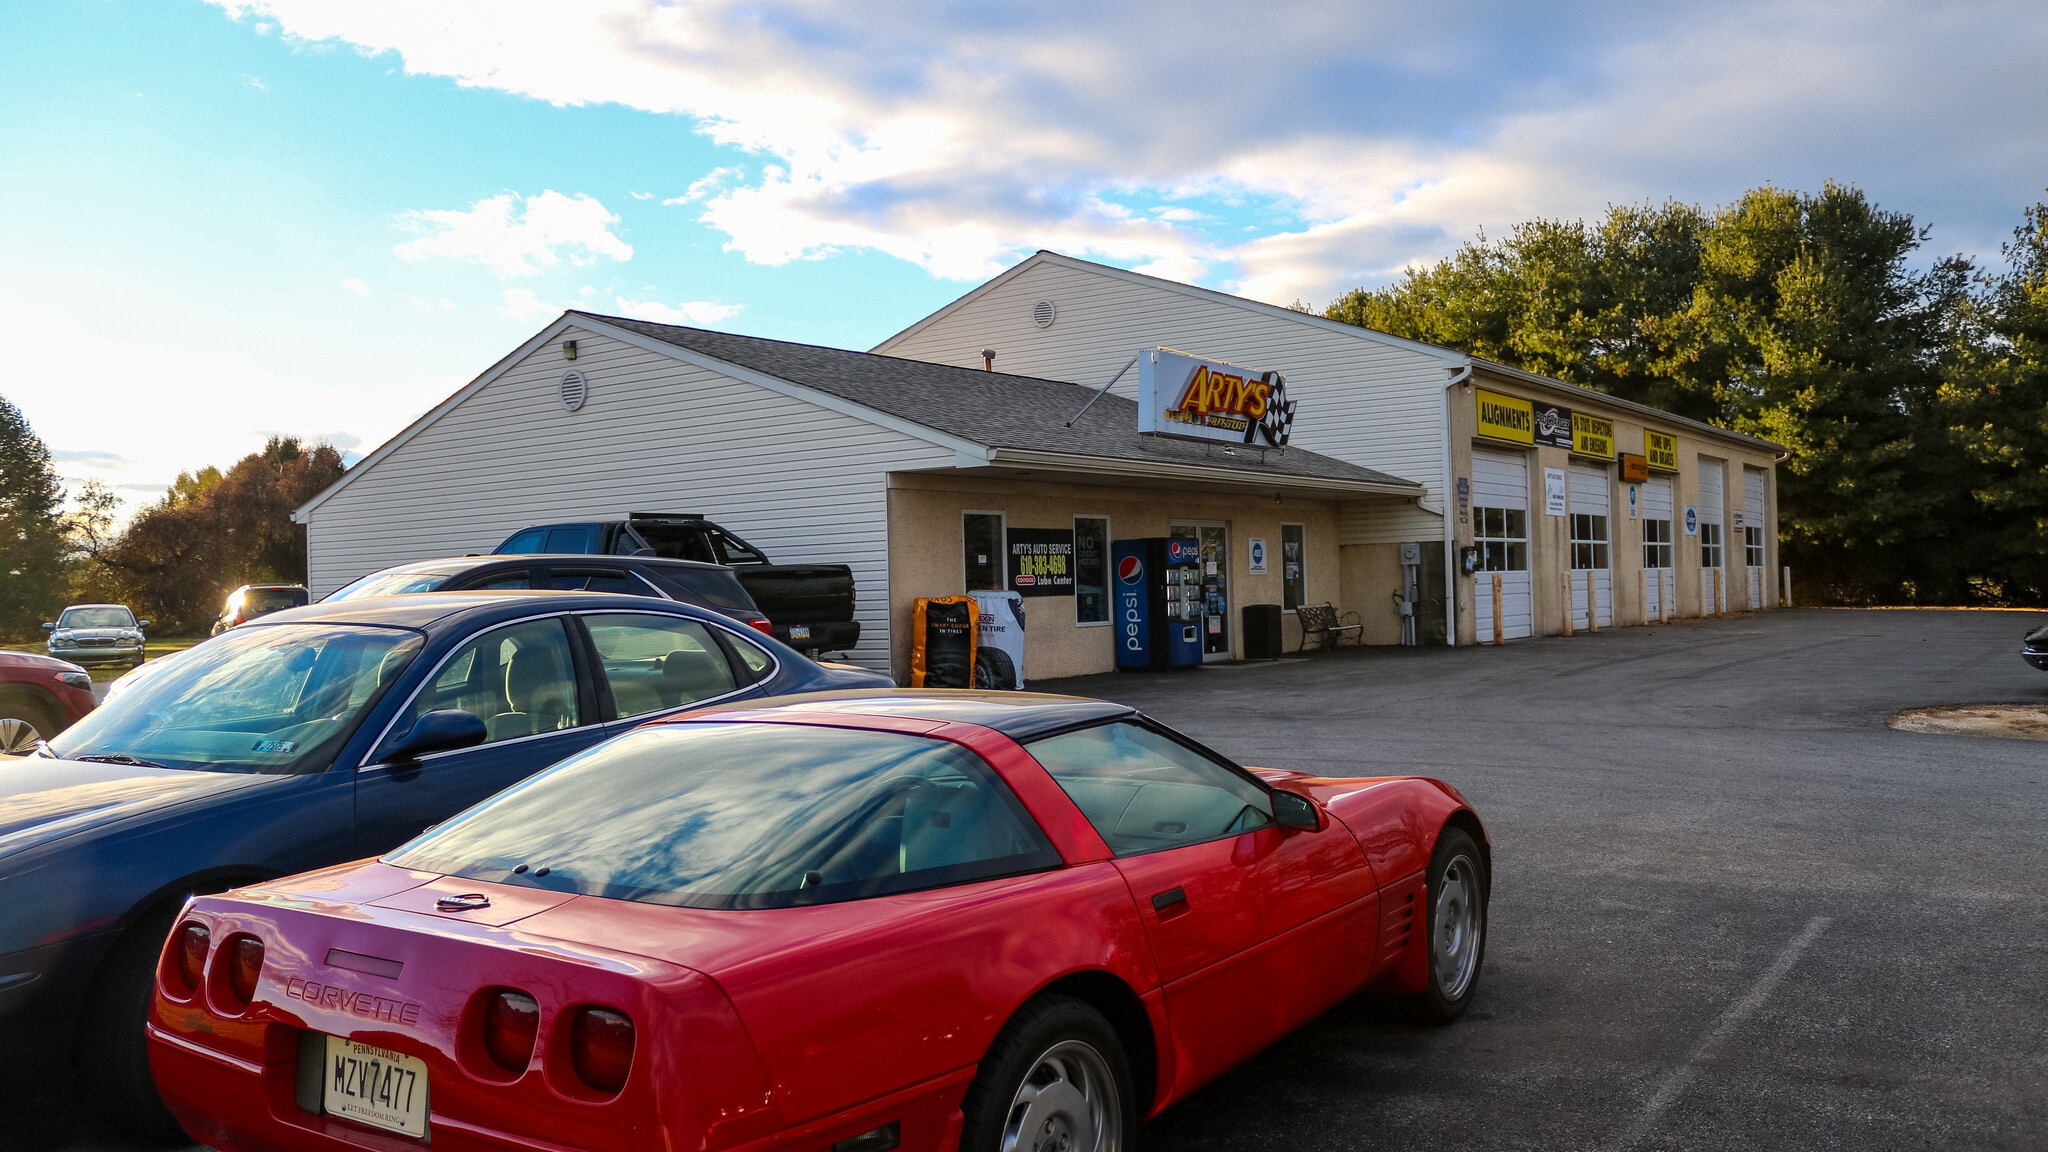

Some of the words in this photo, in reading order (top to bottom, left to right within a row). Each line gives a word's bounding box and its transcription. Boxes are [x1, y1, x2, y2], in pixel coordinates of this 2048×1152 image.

[1179, 365, 1270, 419] ARTY'S
[1481, 401, 1531, 432] ALIGNMENTS
[1012, 544, 1032, 554] ARTY'S
[1033, 544, 1047, 554] AUTO
[1048, 544, 1072, 554] SERVICE
[1077, 536, 1094, 549] NO
[1182, 545, 1199, 557] pepsi
[1020, 555, 1067, 575] 610-383-4698
[1037, 576, 1052, 585] Lube
[1053, 576, 1072, 585] Center
[1122, 592, 1143, 651] pepsi
[286, 977, 421, 1026] CORVETTE
[353, 1044, 400, 1064] PENNSYLVANIA
[334, 1054, 416, 1113] MZV7477
[347, 1103, 358, 1112] LET
[358, 1106, 384, 1120] FREEDOM
[384, 1113, 400, 1124] RING
